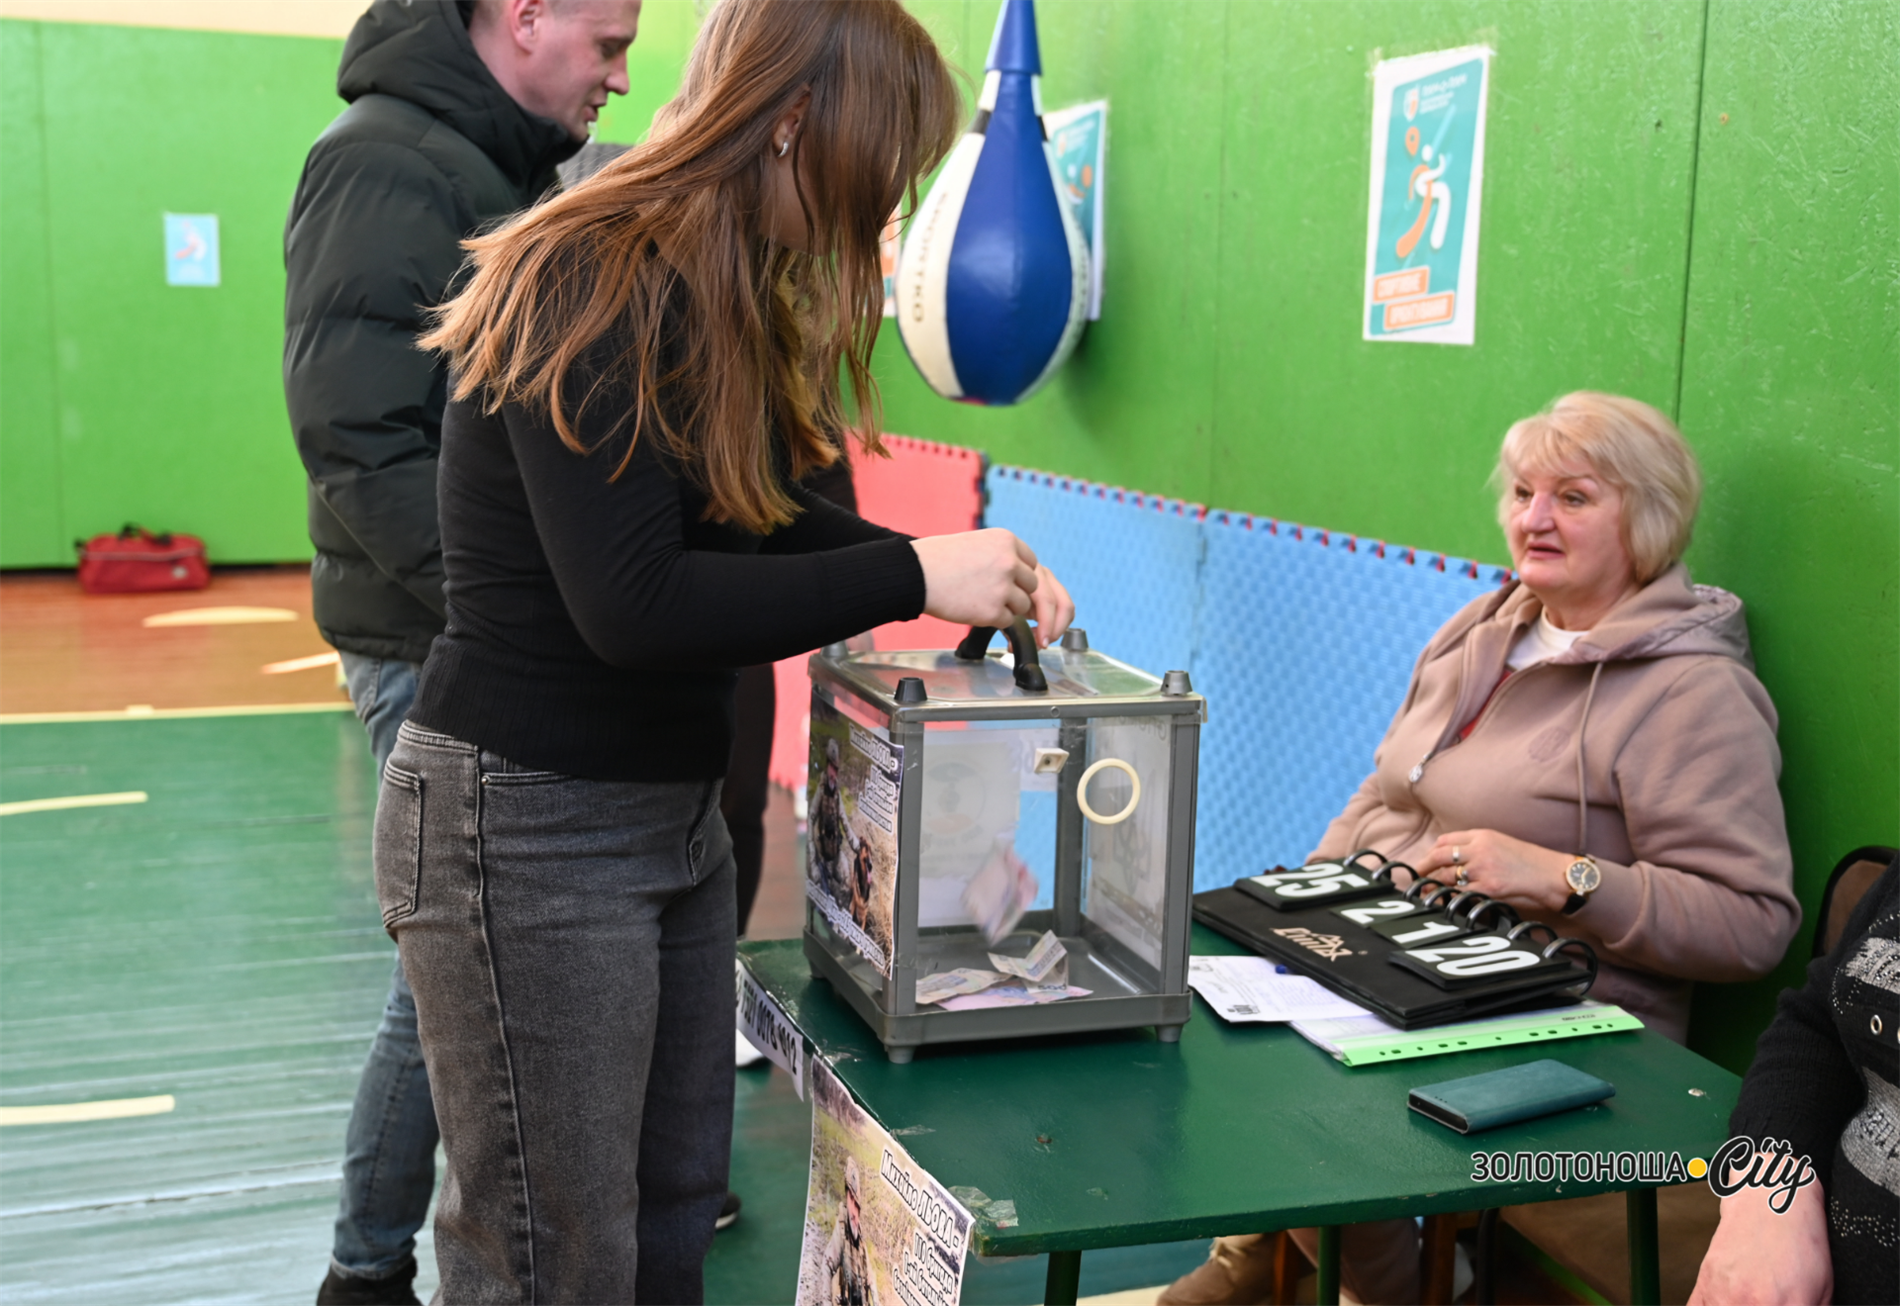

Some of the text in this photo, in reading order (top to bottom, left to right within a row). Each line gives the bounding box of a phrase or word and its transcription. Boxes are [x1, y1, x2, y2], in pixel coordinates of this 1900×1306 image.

[1250, 863, 1370, 898] 25
[1340, 900, 1460, 944] 2 1
[1405, 936, 1541, 976] 20
[881, 1149, 919, 1211] Михайло
[917, 1189, 954, 1249] ЛЬОВА
